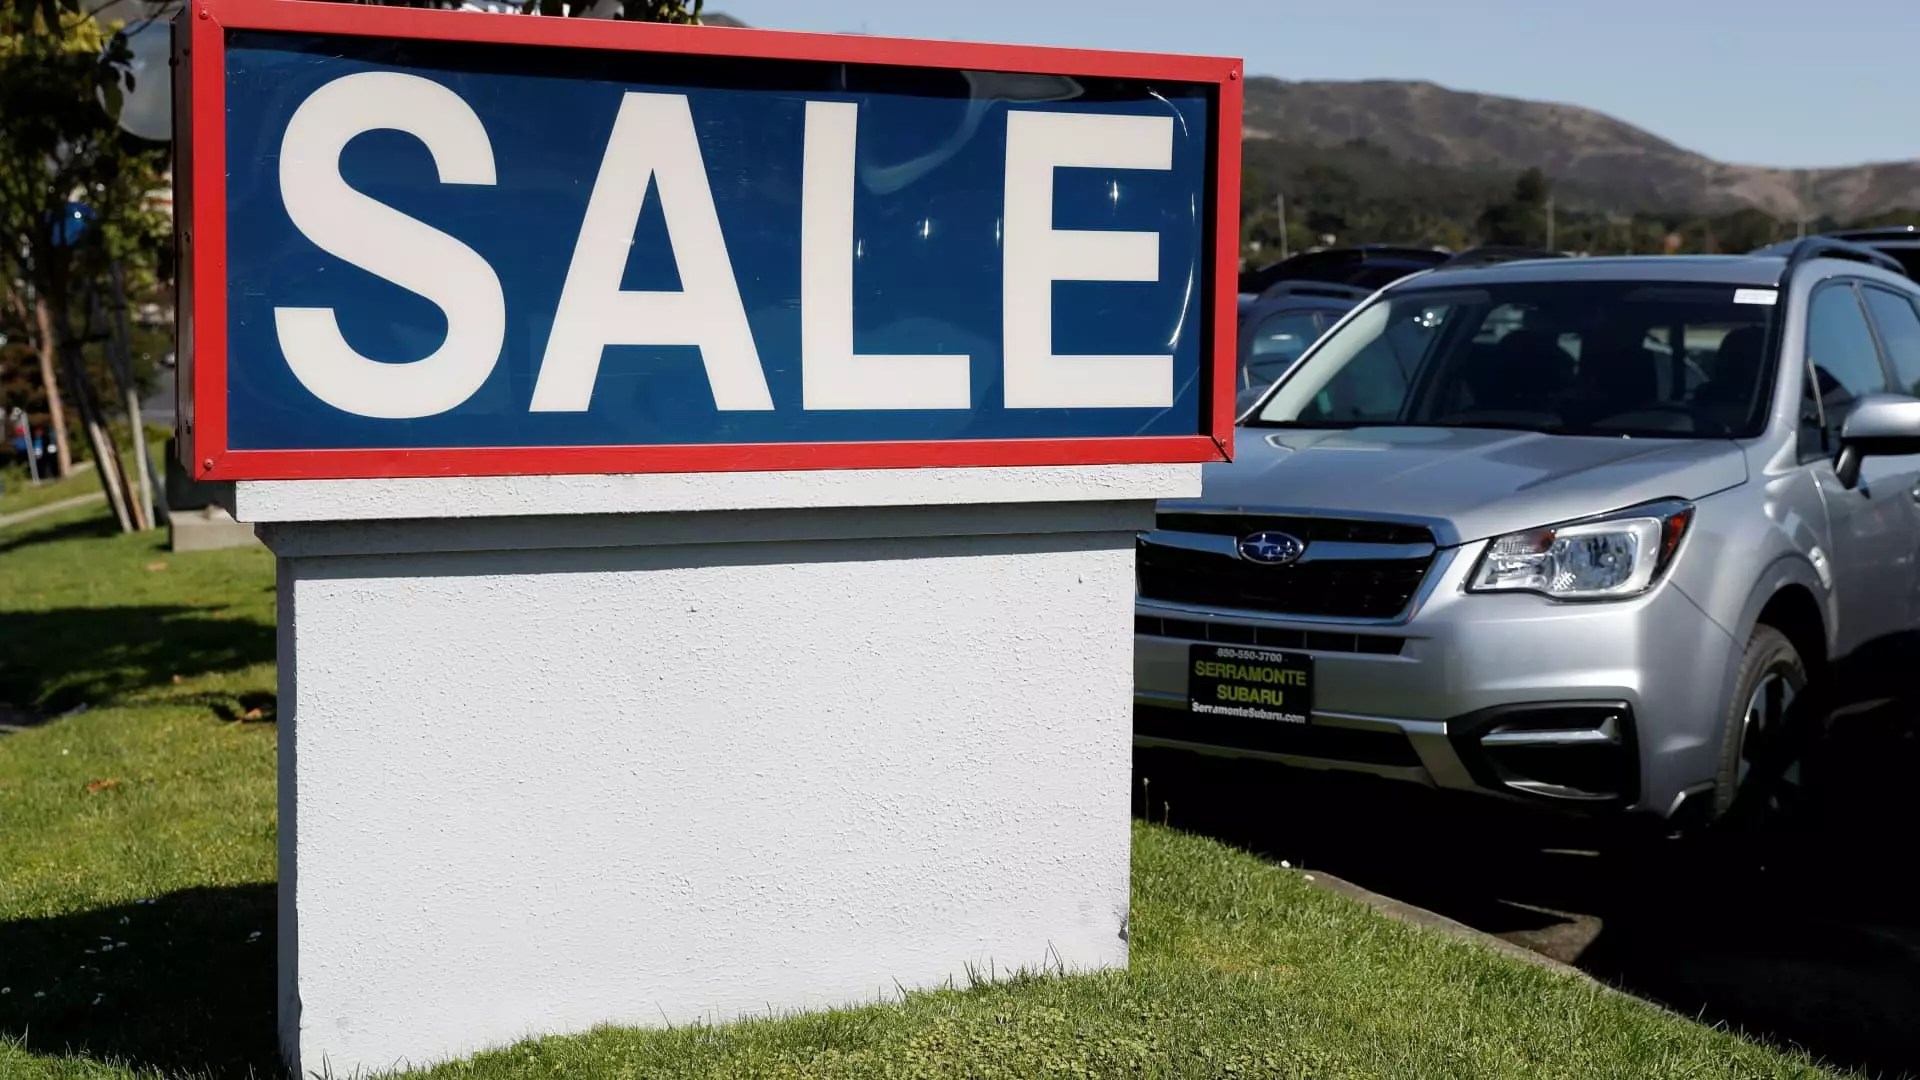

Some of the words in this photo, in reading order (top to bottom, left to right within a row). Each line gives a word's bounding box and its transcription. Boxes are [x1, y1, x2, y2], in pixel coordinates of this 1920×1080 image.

[274, 71, 1174, 419] SALE
[1195, 660, 1307, 686] SERRAMONTE
[1216, 684, 1283, 706] SUBARU
[1192, 701, 1305, 724] SerramonteSubaru.com
